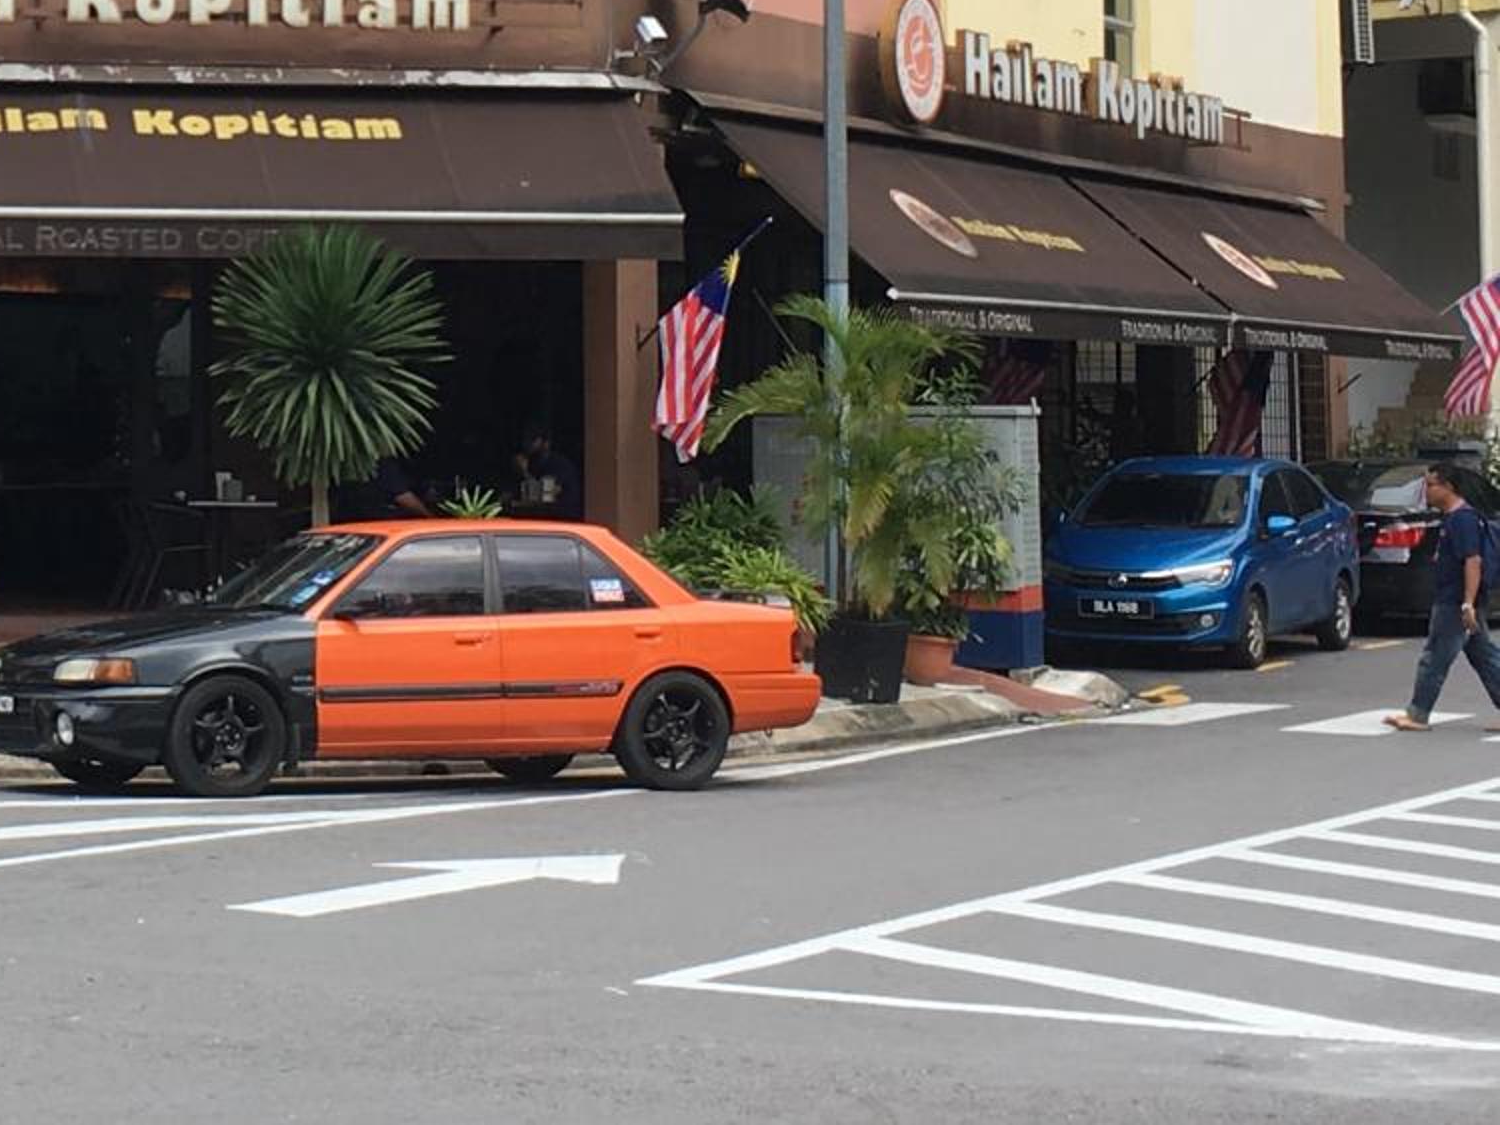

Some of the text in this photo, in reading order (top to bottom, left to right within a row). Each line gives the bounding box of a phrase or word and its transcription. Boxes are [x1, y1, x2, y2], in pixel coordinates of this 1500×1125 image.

[964, 30, 1225, 145] Hailam Kopitiam
[133, 109, 403, 141] Kopitiam
[36, 225, 182, 252] ROASTED
